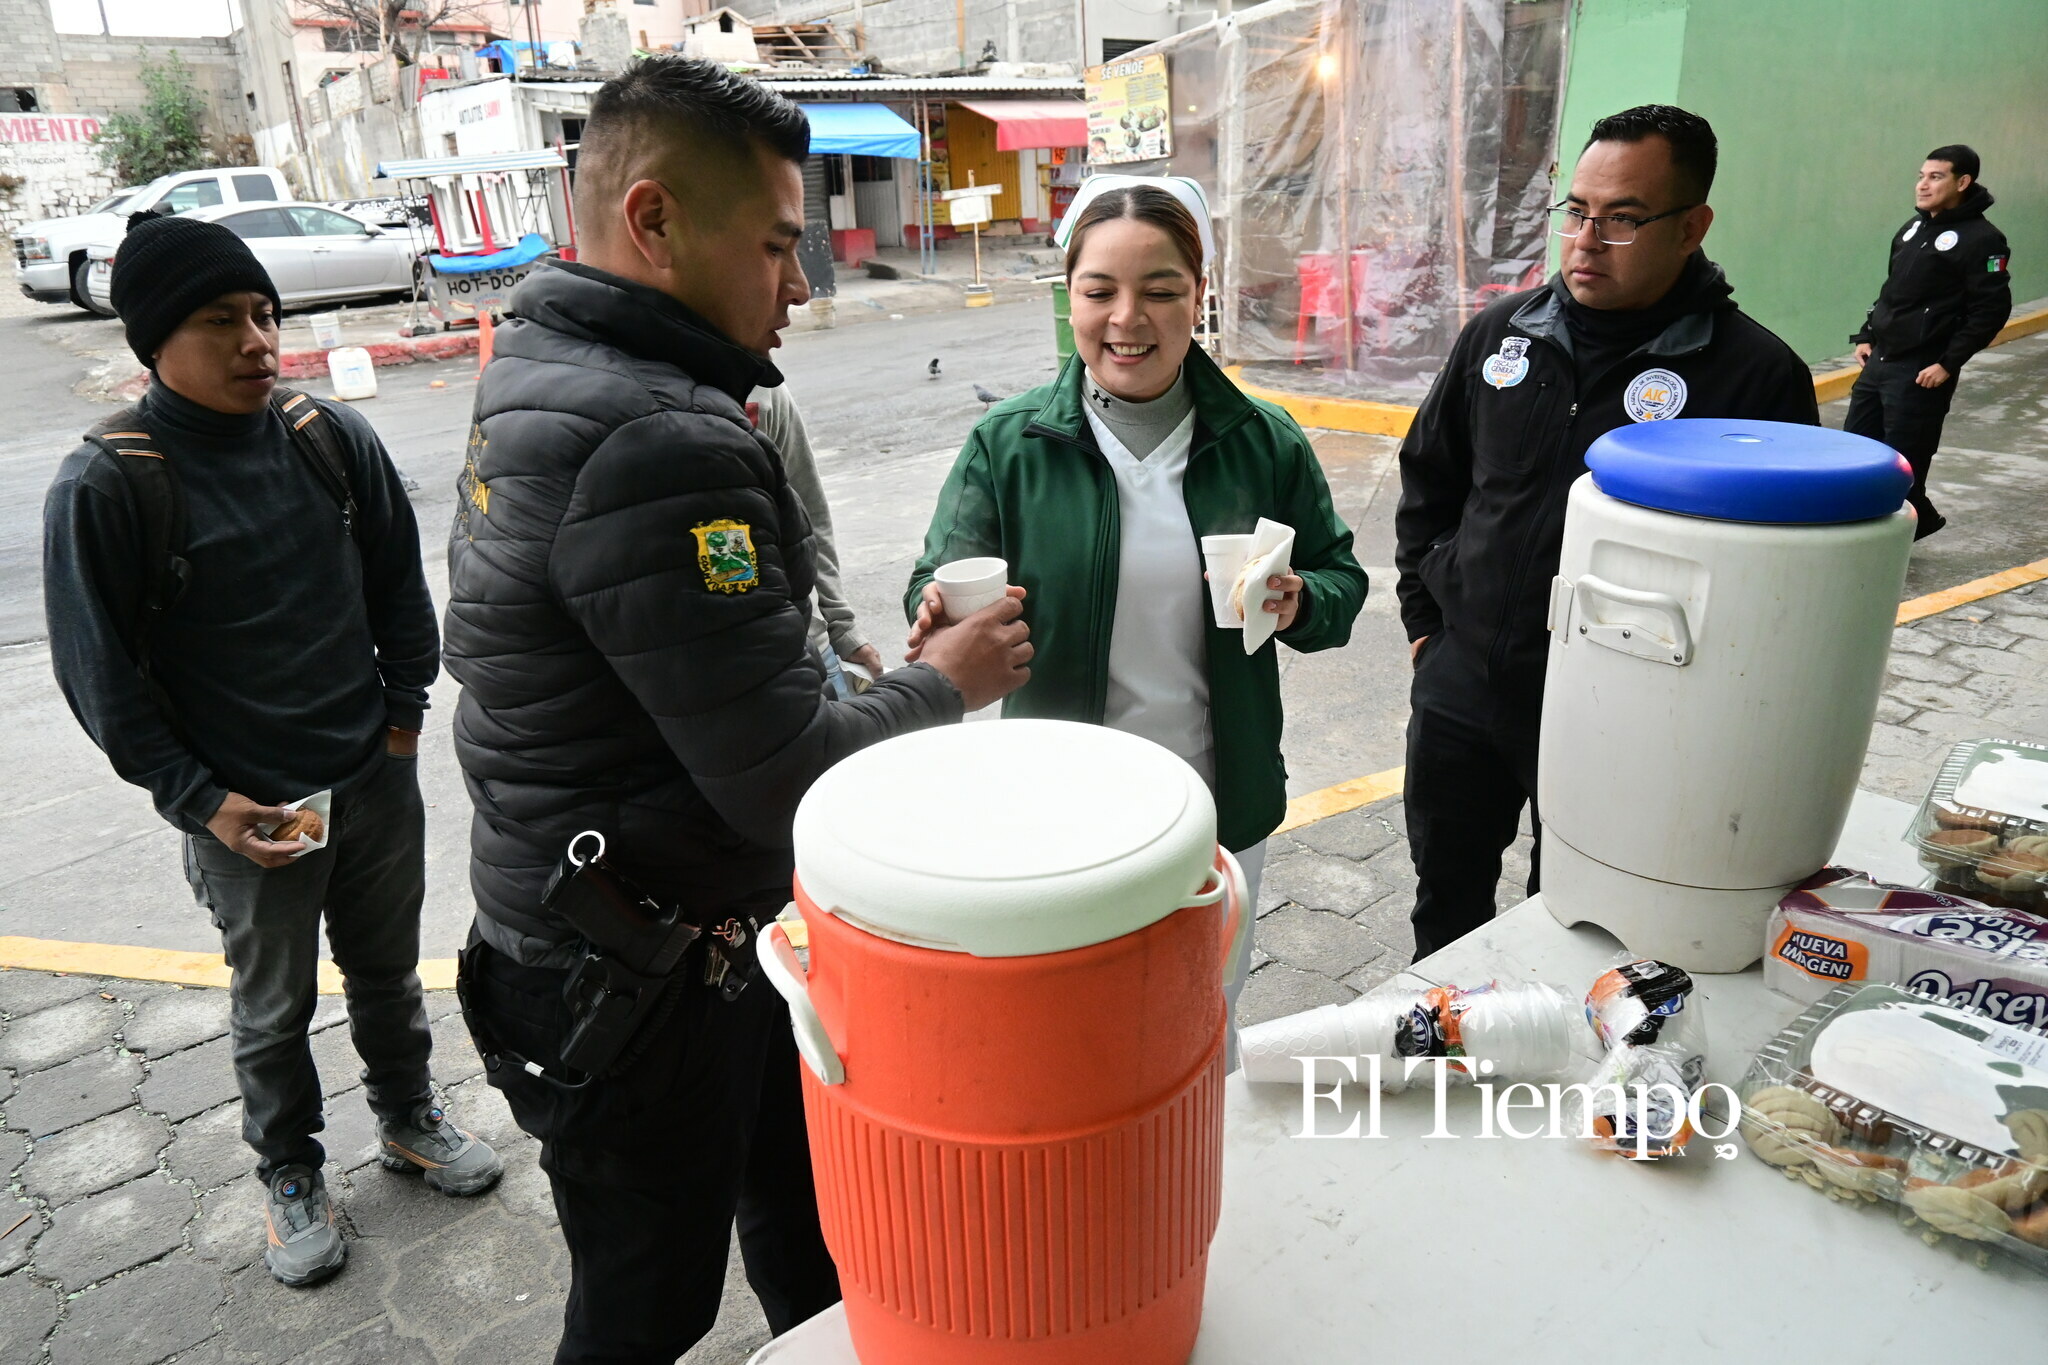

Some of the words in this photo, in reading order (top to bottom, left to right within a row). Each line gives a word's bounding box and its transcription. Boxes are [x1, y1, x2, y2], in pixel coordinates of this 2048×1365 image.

[1101, 65, 1112, 80] SE
[1113, 60, 1145, 79] VENDE
[1491, 366, 1516, 374] GENERAL
[1642, 388, 1669, 402] AIC
[1791, 933, 1845, 958] NUEVA
[1781, 943, 1852, 978] IMAGEN!
